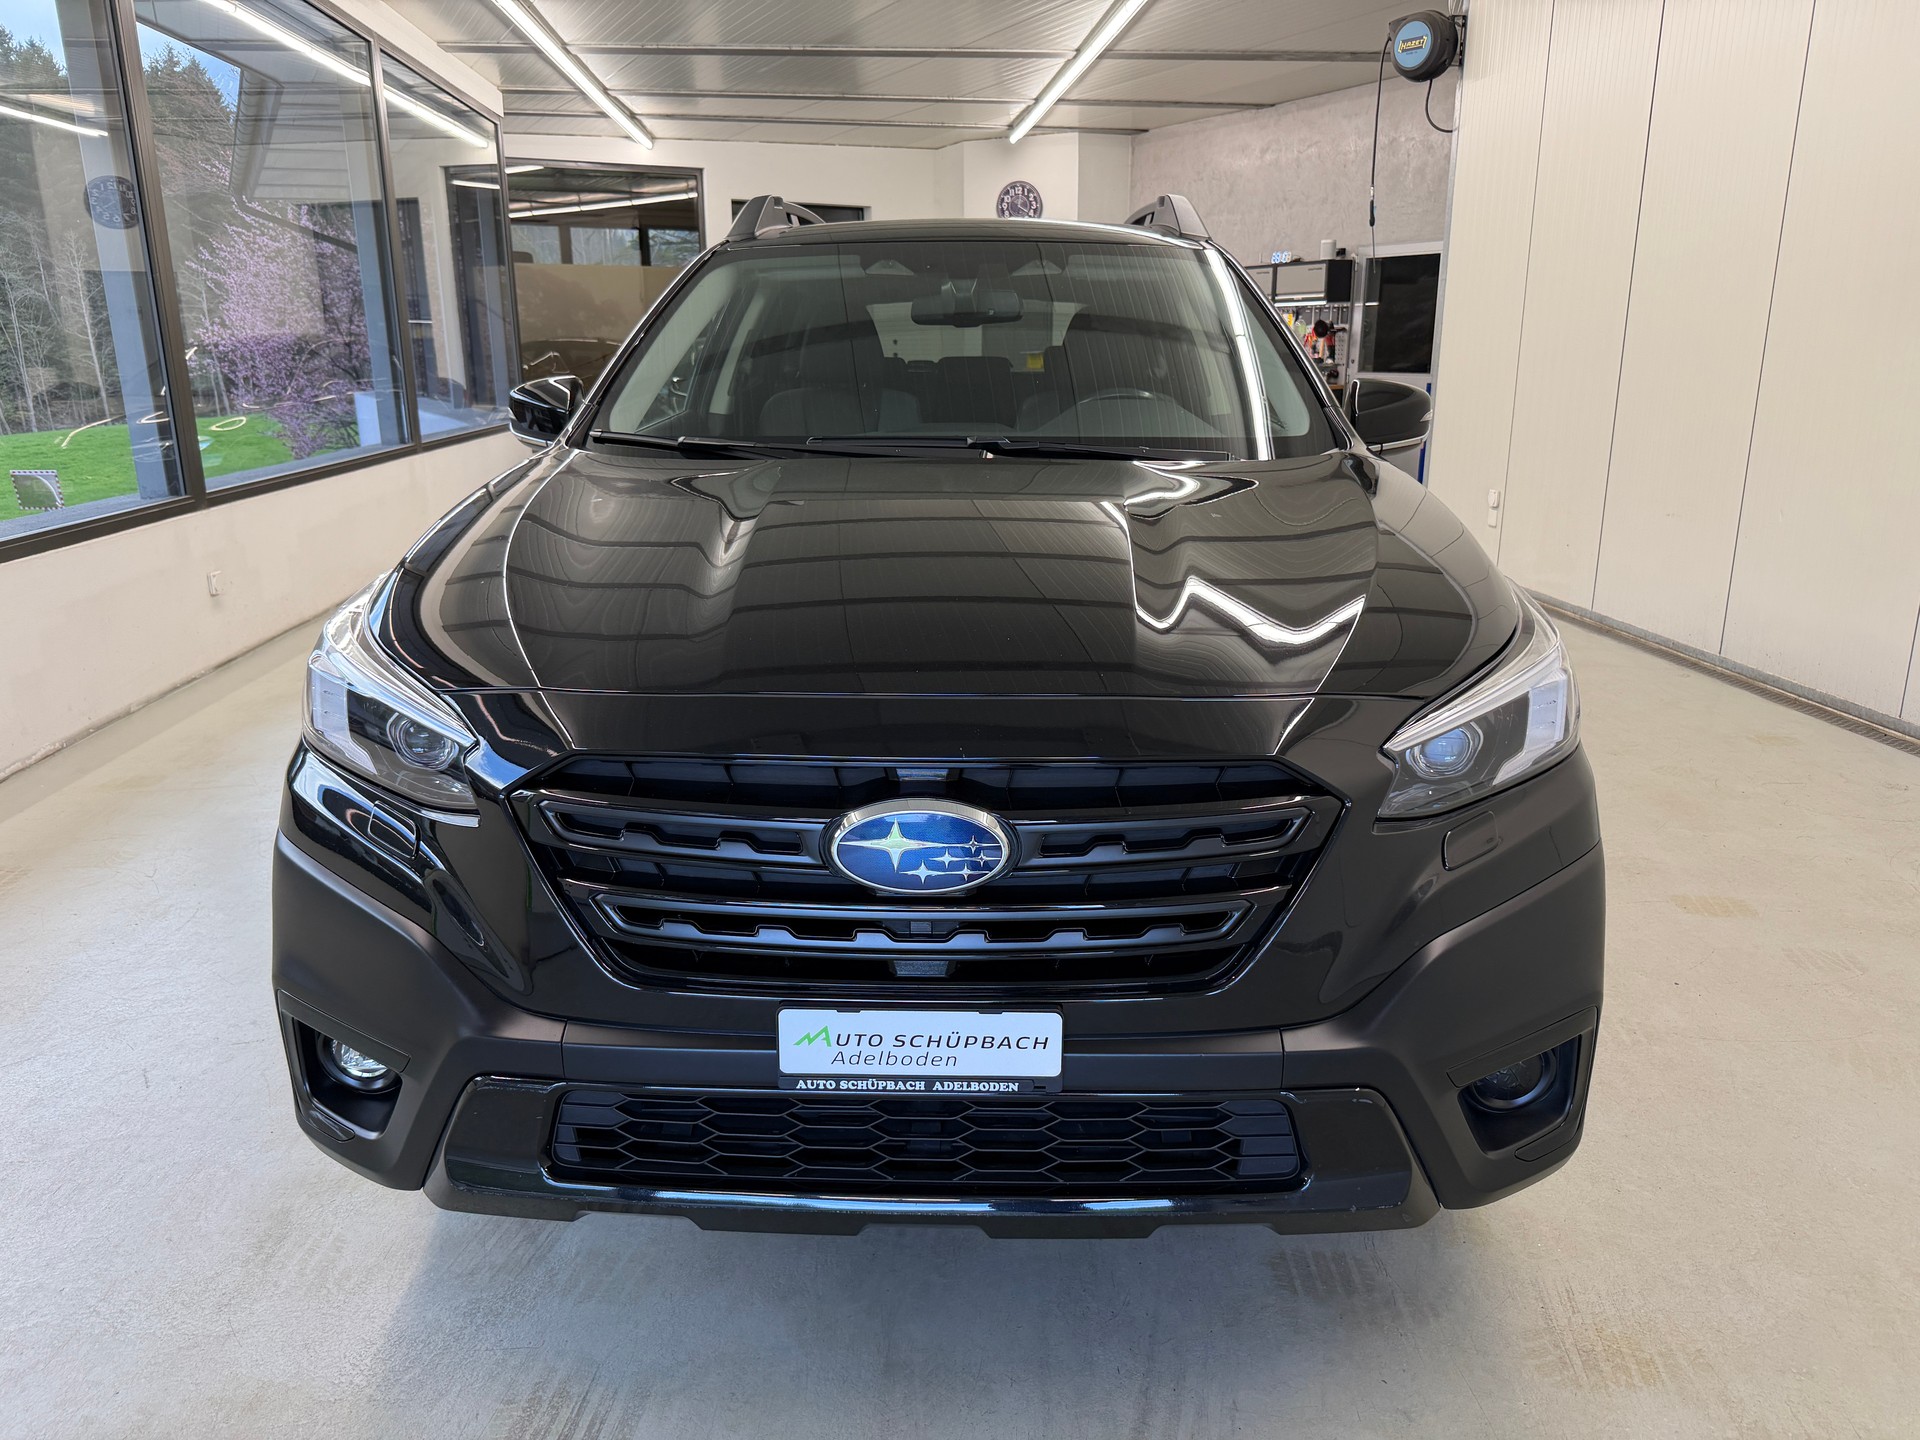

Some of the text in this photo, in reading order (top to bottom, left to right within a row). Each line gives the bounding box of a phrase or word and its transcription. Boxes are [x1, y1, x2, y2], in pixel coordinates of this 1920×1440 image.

[1015, 186, 1023, 195] 12
[892, 1031, 1050, 1050] SCHÜPBACH
[831, 1050, 958, 1067] Adelboden
[796, 1078, 1019, 1092] AUTO SCHÜPBACH ADELBODEN
